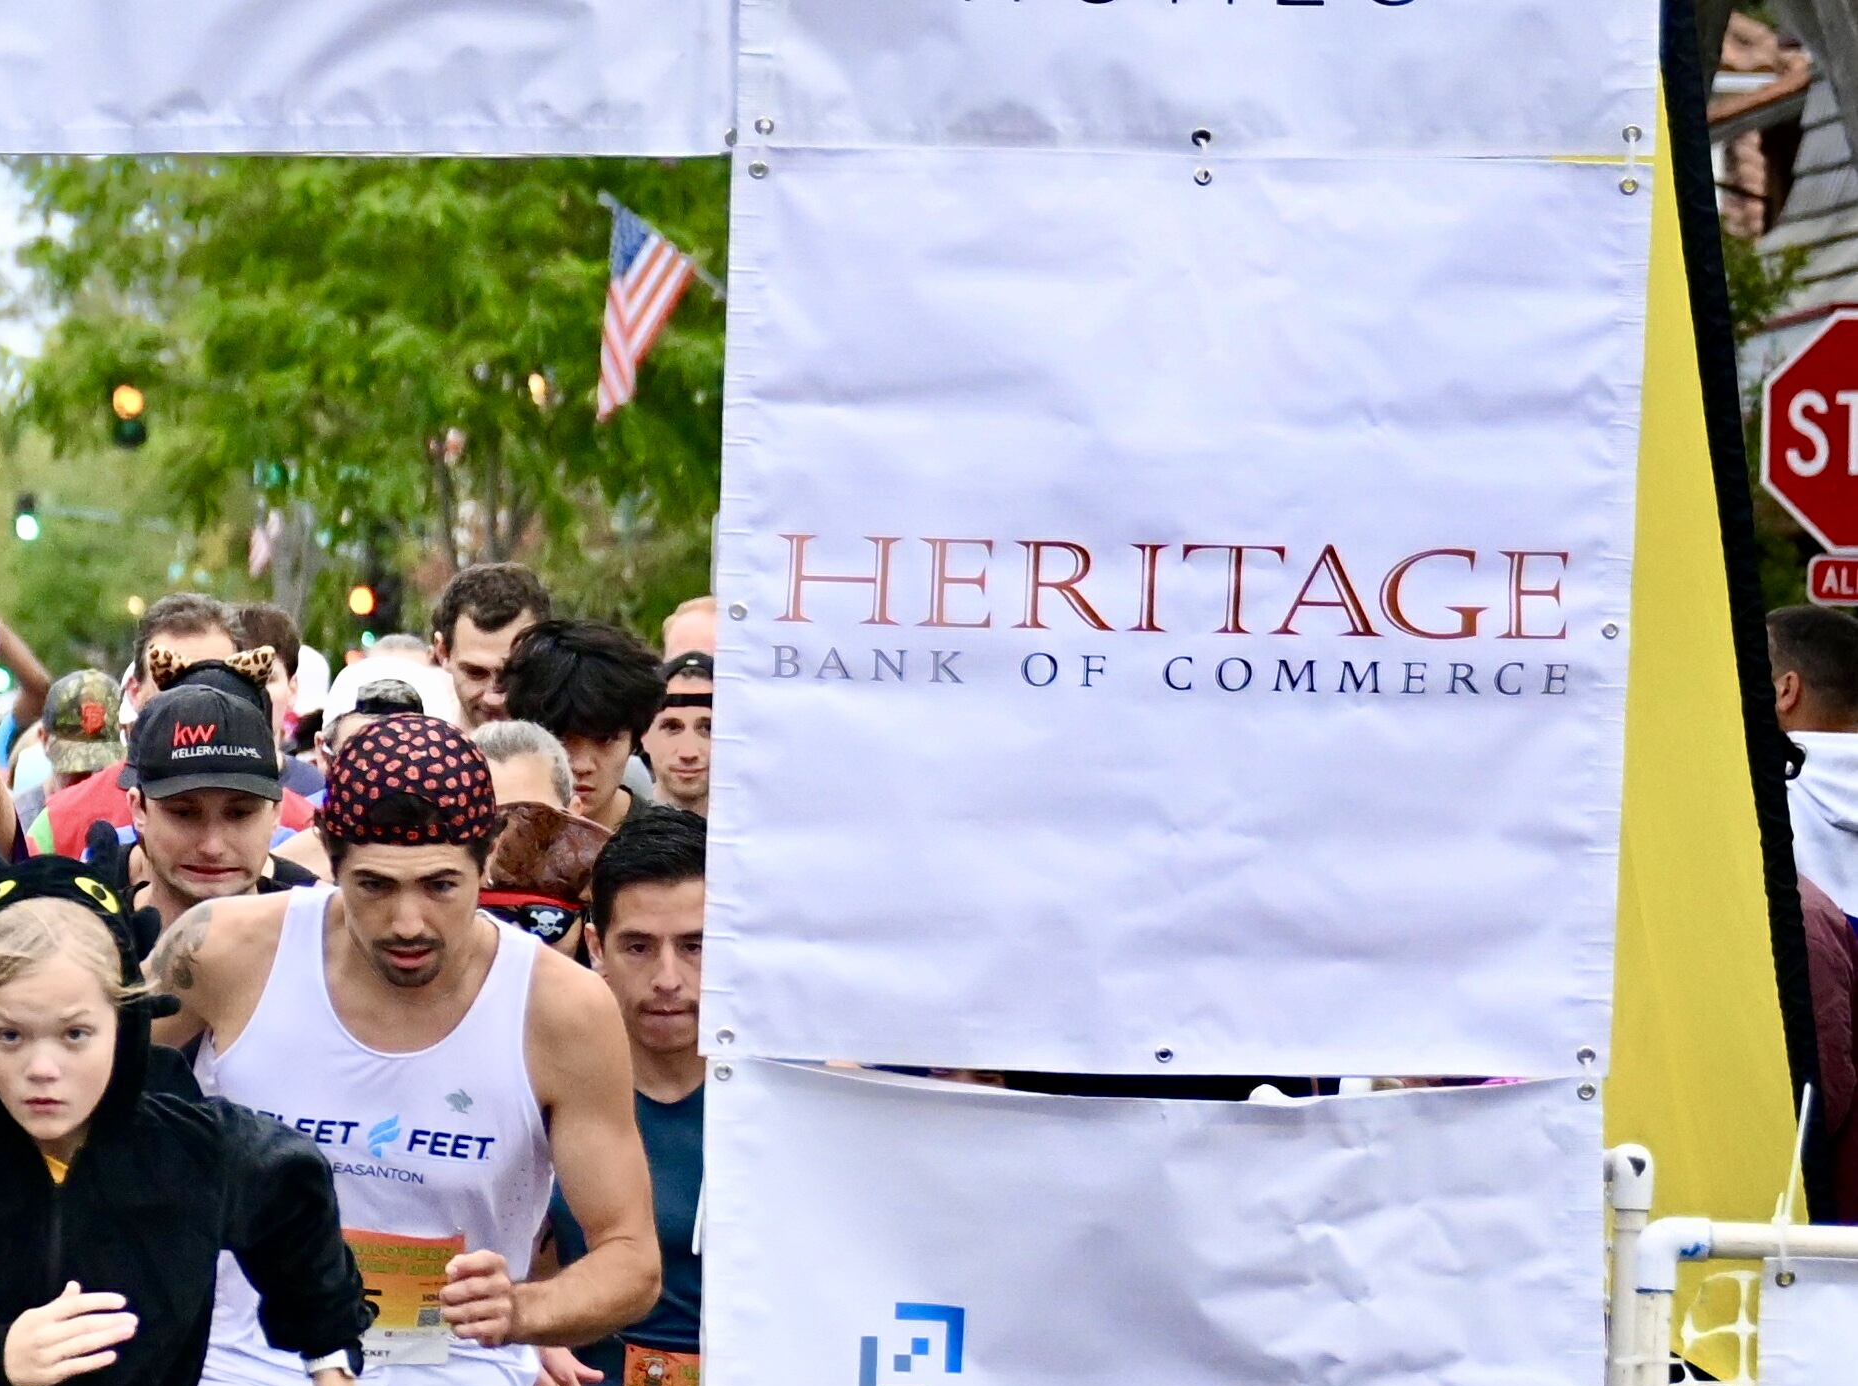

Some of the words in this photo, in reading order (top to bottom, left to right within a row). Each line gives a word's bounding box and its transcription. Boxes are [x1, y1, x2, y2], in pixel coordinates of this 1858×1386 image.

[773, 534, 1570, 641] HERITAGE
[1821, 564, 1858, 595] AL
[772, 645, 965, 684] BANK
[1021, 652, 1107, 688] OF
[1162, 656, 1570, 696] COMMERCE
[173, 720, 216, 747] kw
[257, 1110, 359, 1145] EET
[406, 1128, 495, 1161] FEET
